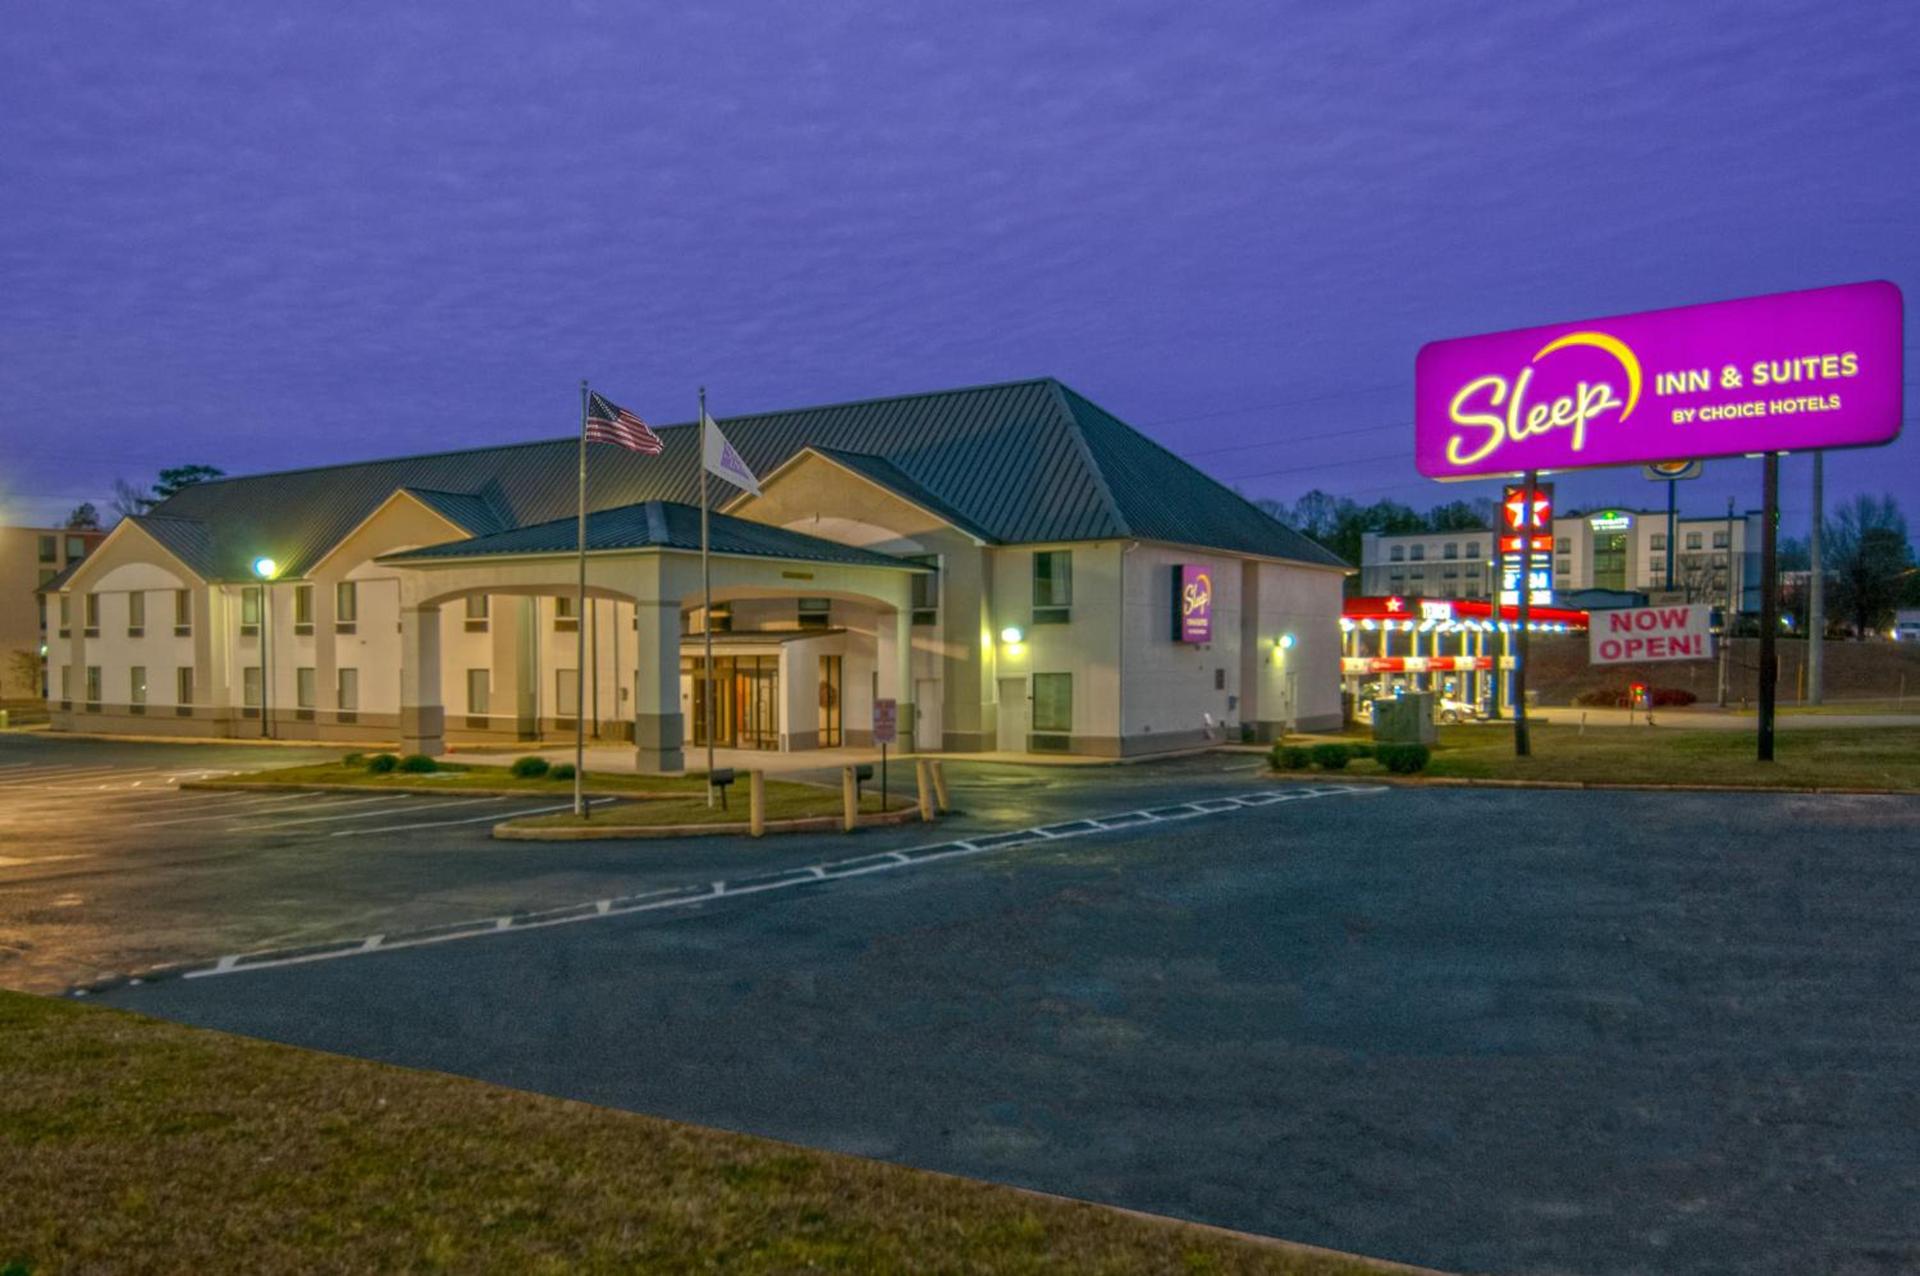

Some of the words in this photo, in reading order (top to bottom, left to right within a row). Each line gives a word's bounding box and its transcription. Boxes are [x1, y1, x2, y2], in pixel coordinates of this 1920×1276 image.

[1655, 368, 1710, 396] INN
[1720, 364, 1743, 389] &
[1752, 352, 1859, 385] SUITES
[1446, 366, 1622, 465] Sleep
[1672, 408, 1695, 424] BY
[1699, 400, 1766, 422] CHOICE
[1770, 394, 1841, 415] HOTELS
[1610, 608, 1689, 633] NOW
[1599, 634, 1702, 661] OPEN!
